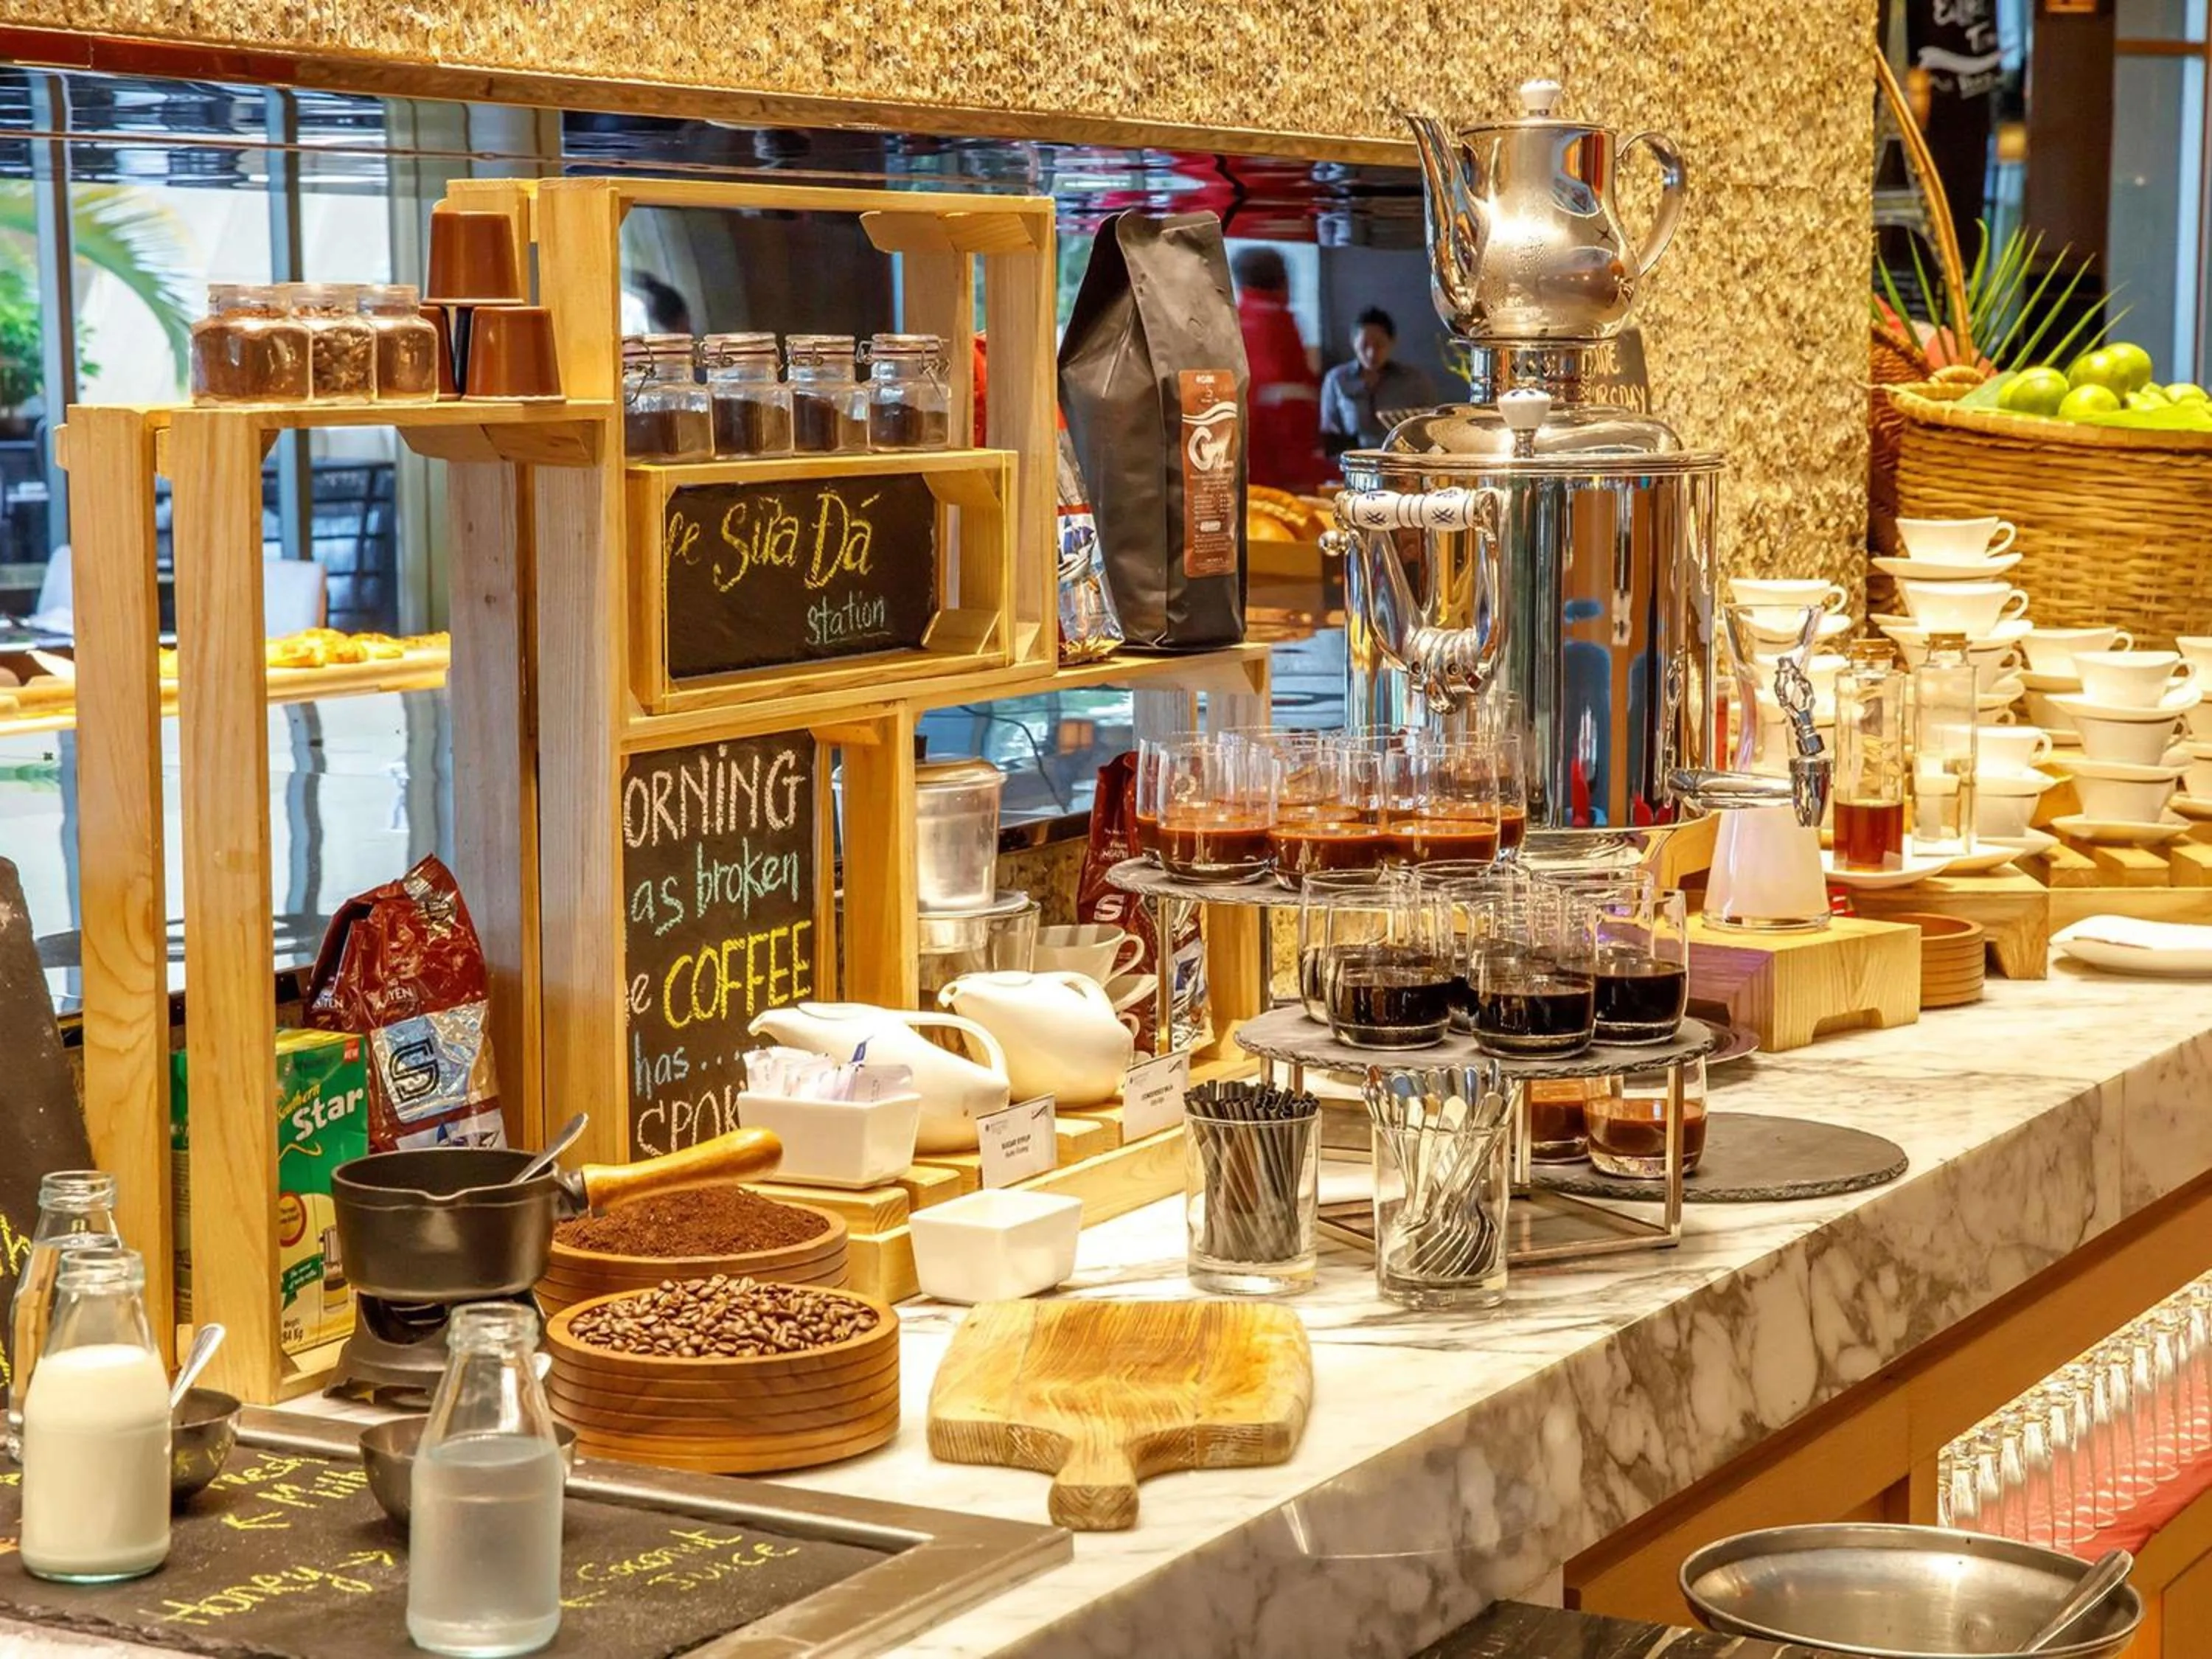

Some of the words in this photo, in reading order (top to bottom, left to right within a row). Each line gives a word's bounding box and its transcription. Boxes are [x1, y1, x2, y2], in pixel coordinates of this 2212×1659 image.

[623, 744, 807, 848] ORNING
[630, 876, 685, 937] as
[697, 837, 799, 920] broken
[664, 920, 813, 1029] COFFEE
[292, 1088, 364, 1142] Star
[637, 1082, 746, 1156] SPOK
[136, 1565, 373, 1625] Honey
